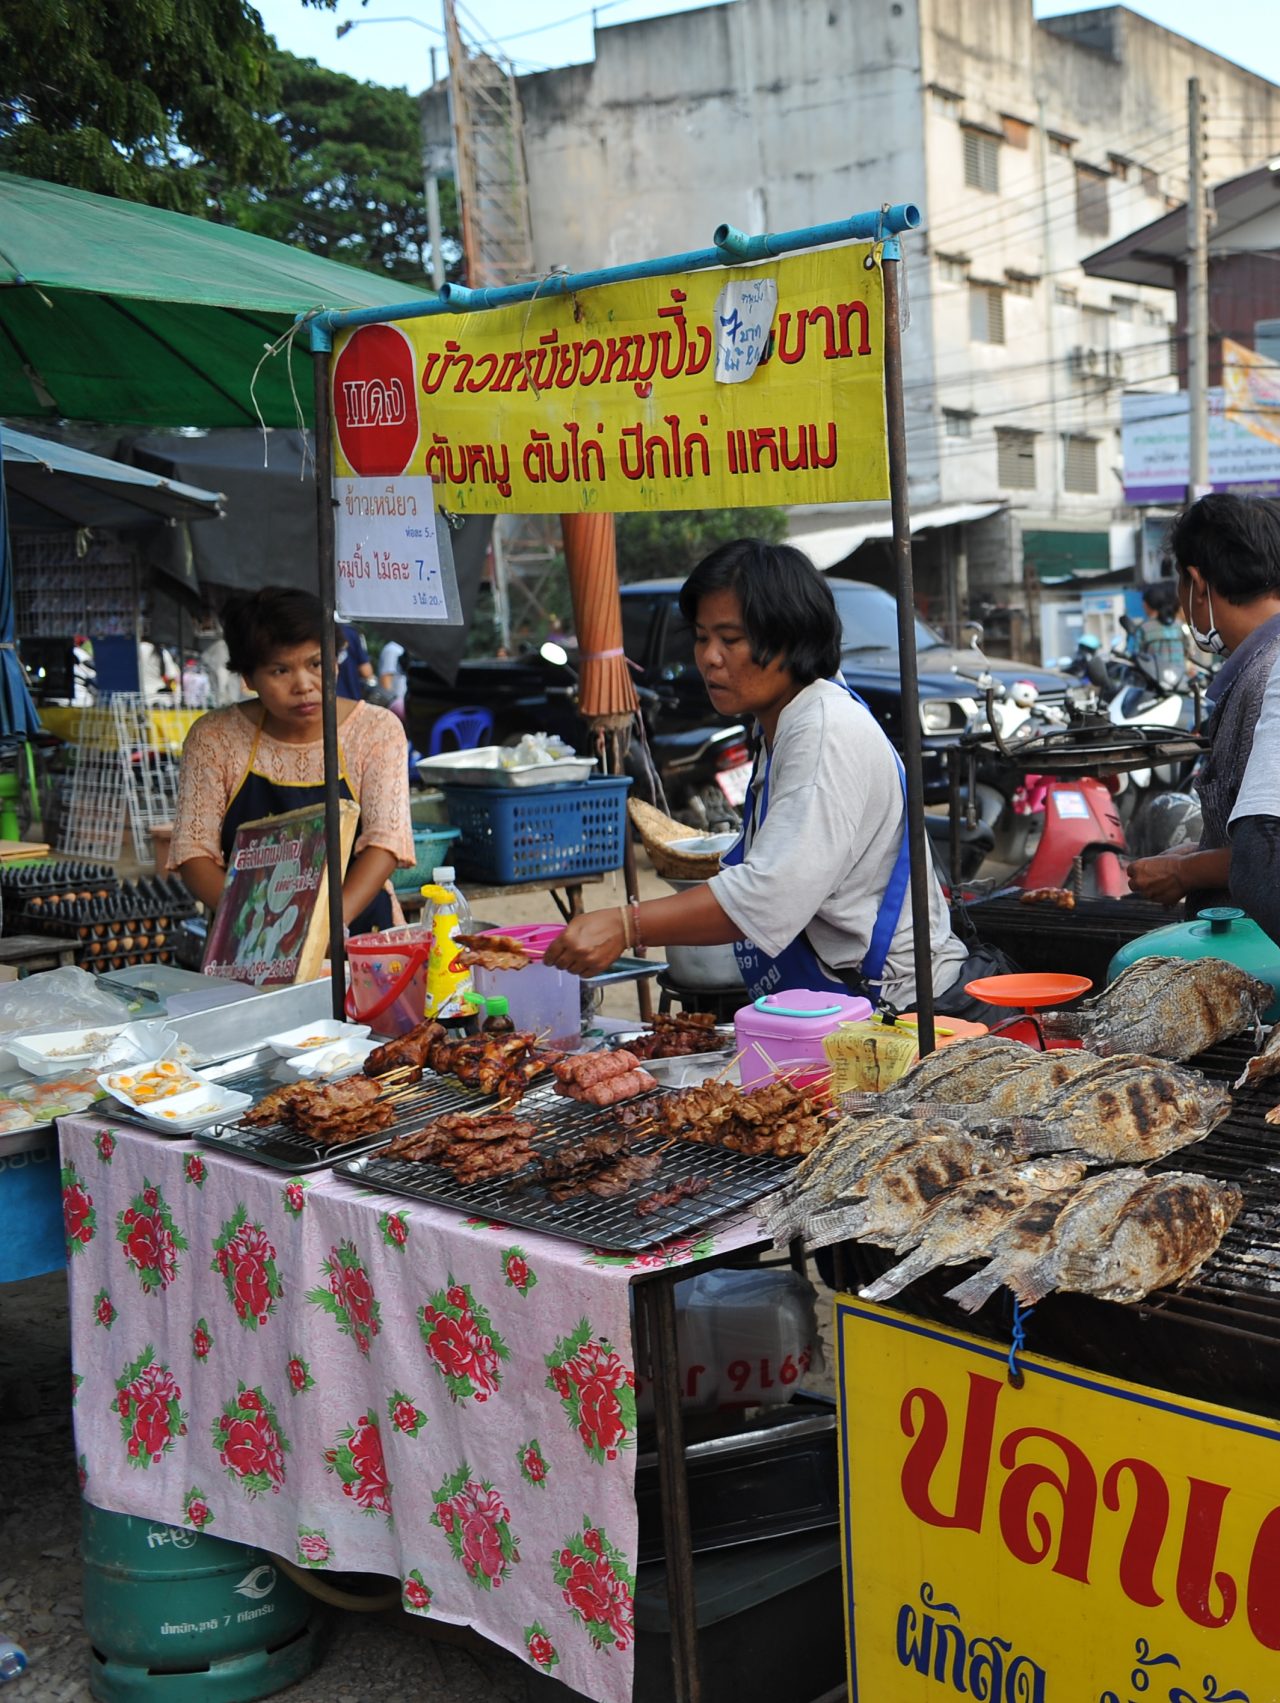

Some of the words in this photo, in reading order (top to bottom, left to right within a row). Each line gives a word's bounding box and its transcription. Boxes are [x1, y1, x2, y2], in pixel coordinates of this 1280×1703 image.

[421, 288, 712, 399] ข้าวเหนียวหมูปิ้ง
[343, 378, 408, 428] แดง
[424, 432, 513, 498] ตับหมู
[522, 421, 606, 484] ตับไก่
[618, 414, 711, 480] ปีกไก่
[727, 422, 839, 475] แหนม
[345, 483, 418, 516] ข้าวเหนียว
[336, 543, 371, 589] หมูปิ้ง
[373, 550, 411, 581] ไม้ละ
[895, 1581, 1047, 1703] ผักสด
